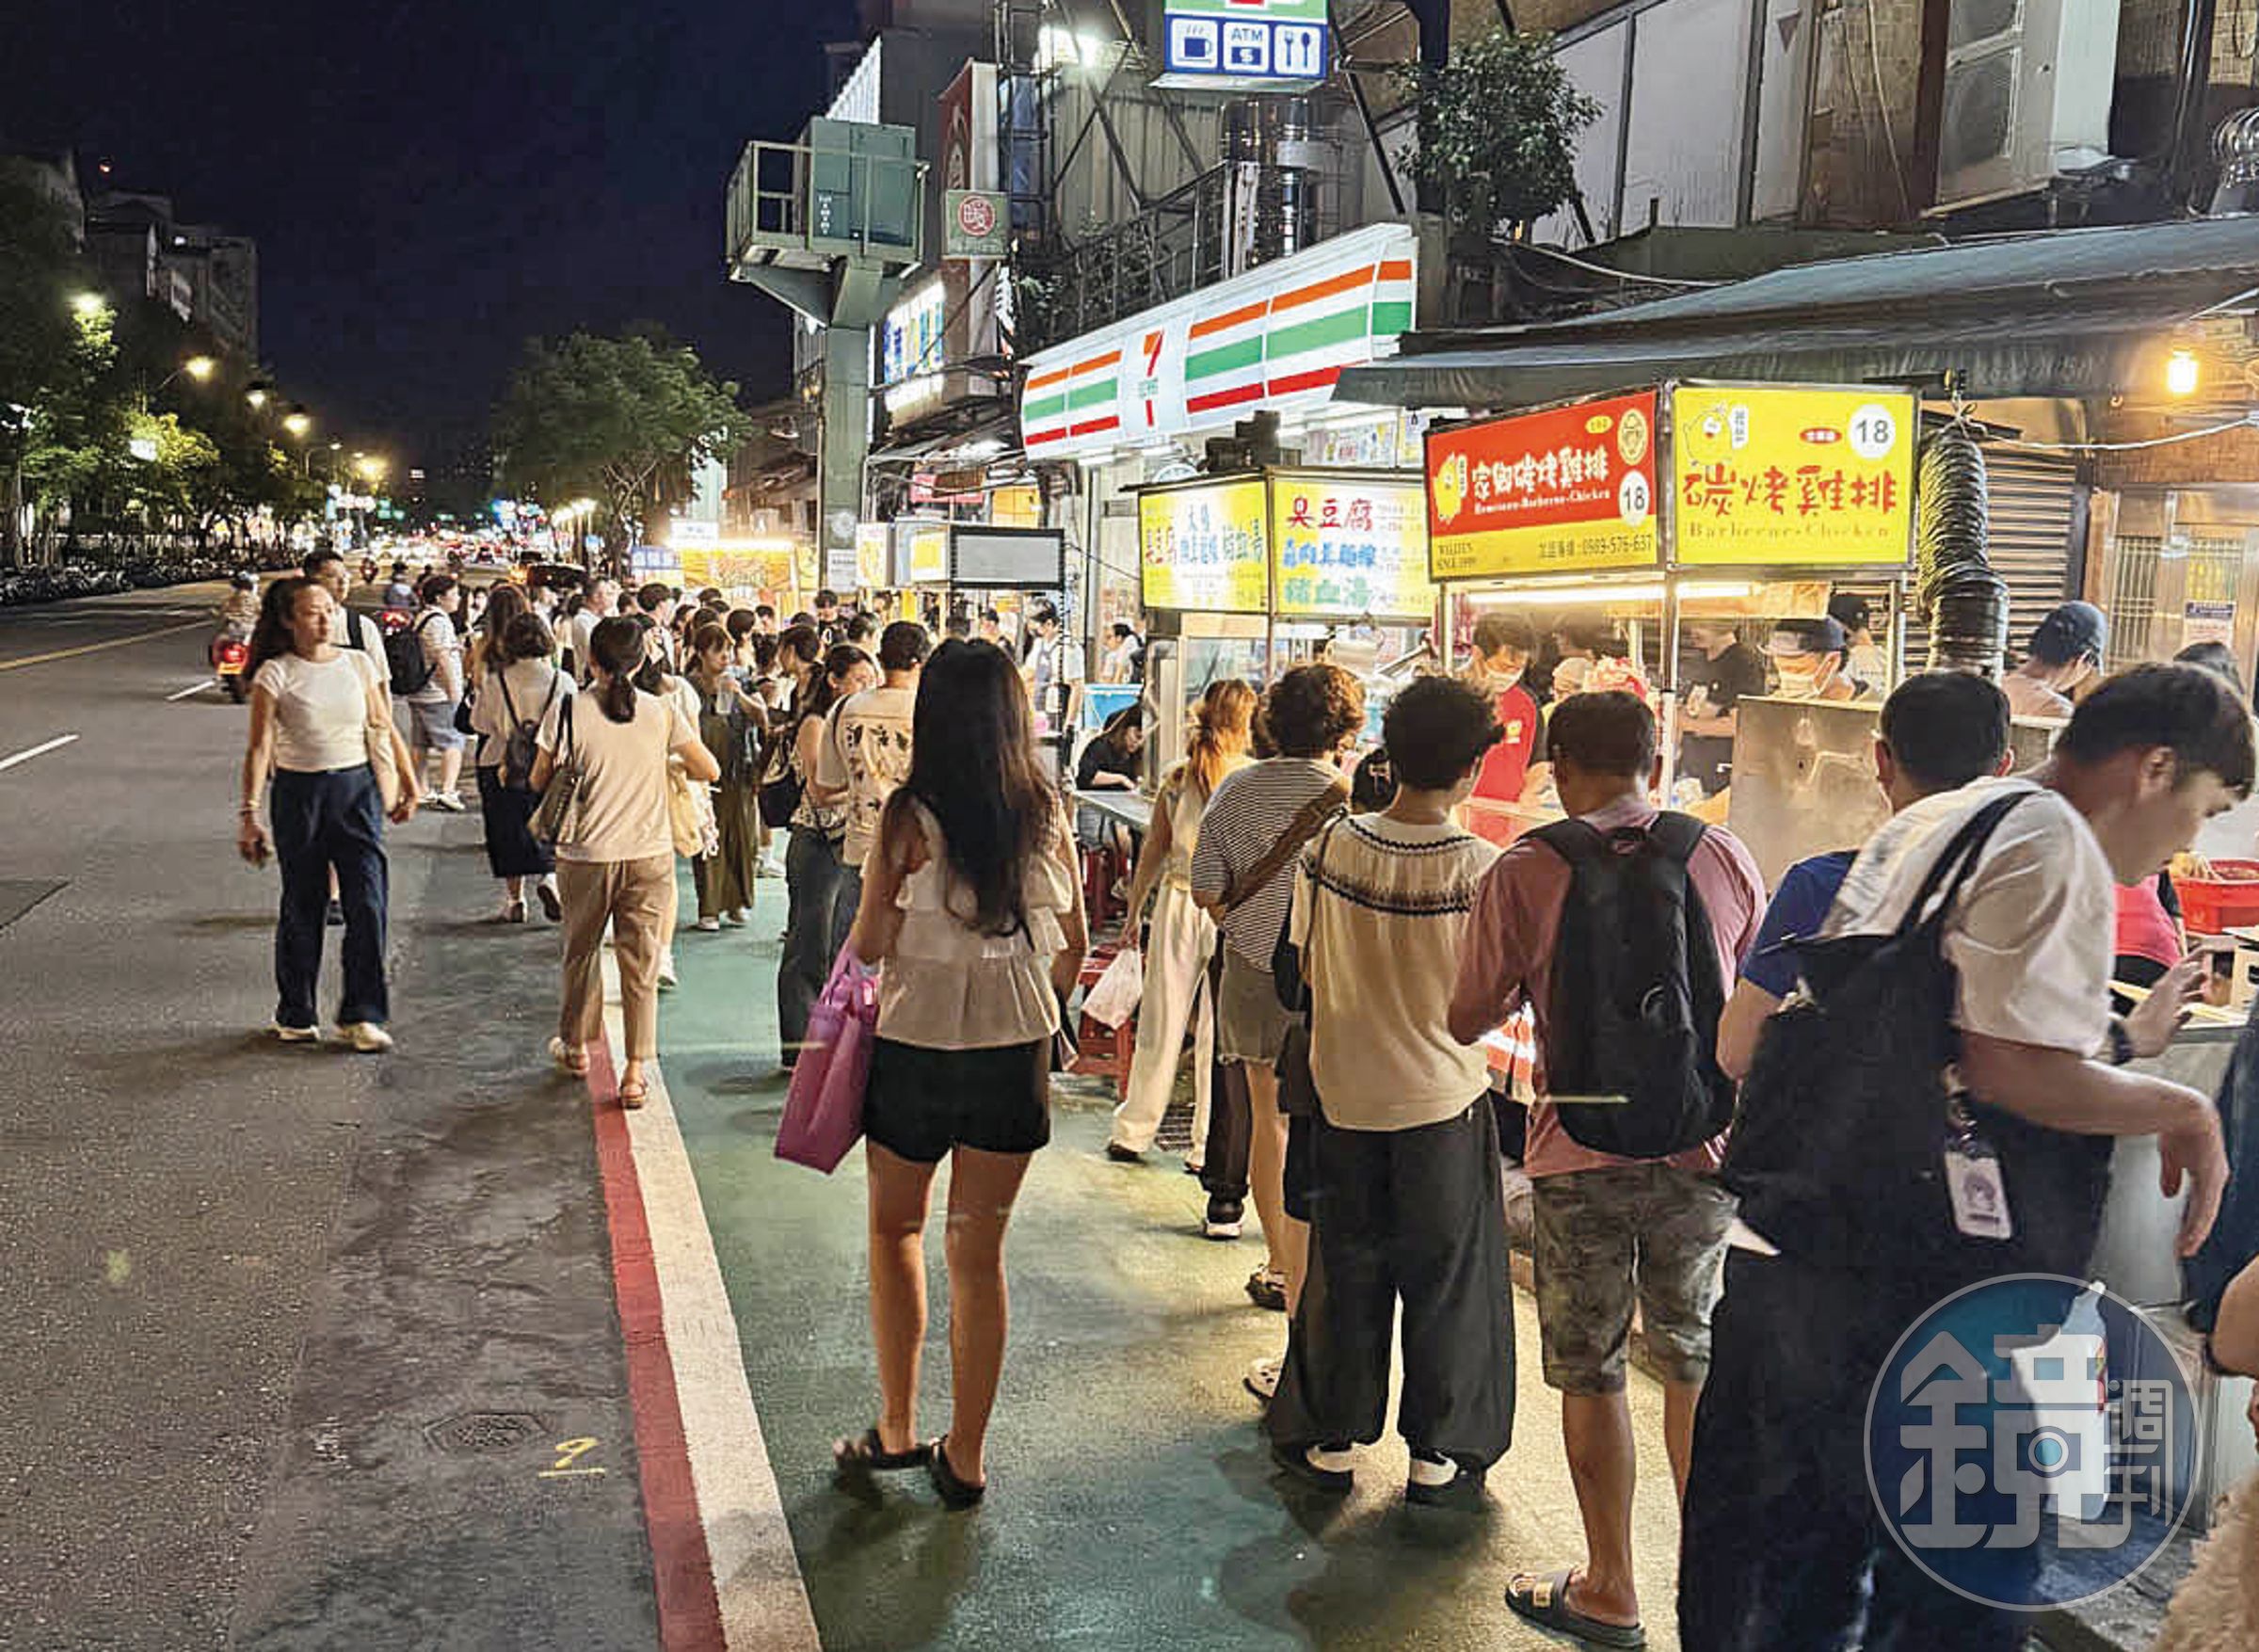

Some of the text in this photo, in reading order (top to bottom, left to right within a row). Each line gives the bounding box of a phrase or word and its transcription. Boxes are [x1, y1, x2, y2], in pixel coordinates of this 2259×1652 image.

[1231, 27, 1263, 42] ATM
[1856, 419, 1890, 444] 18
[1623, 485, 1646, 512] 18
[1683, 462, 1898, 518] 碳烤雞排
[1286, 495, 1373, 533] 臭豆腐
